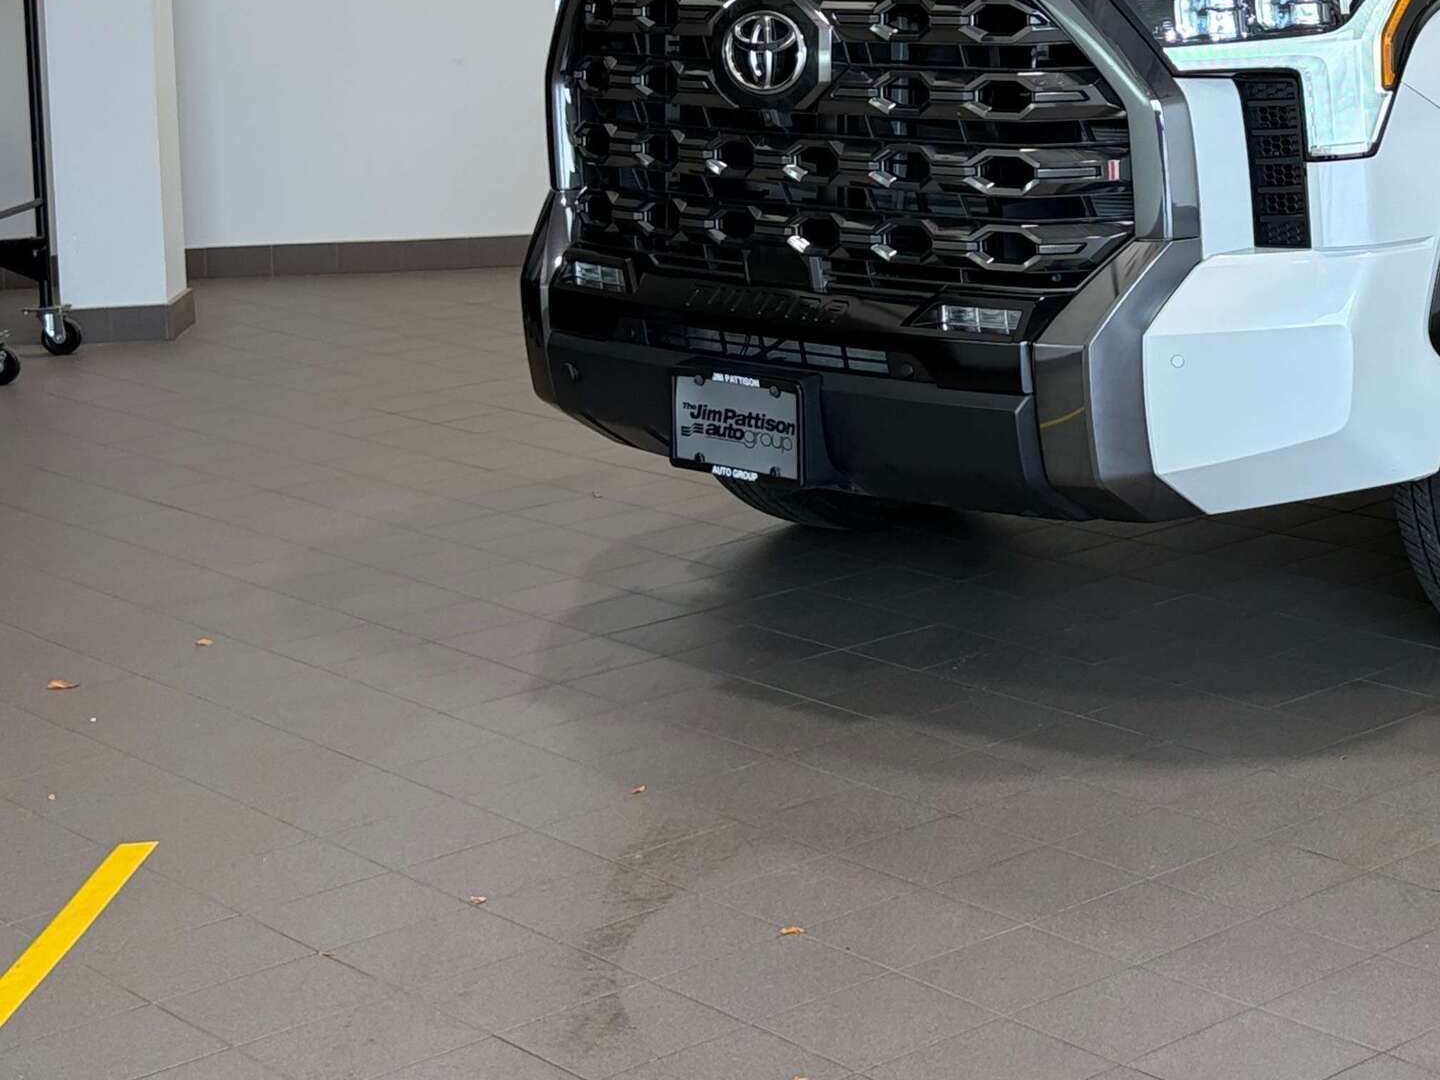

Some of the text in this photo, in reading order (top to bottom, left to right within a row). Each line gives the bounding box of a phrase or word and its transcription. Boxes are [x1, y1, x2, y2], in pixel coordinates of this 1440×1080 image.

[682, 401, 796, 436] The Jim Pattison
[711, 464, 759, 482] AUTO GROUP
